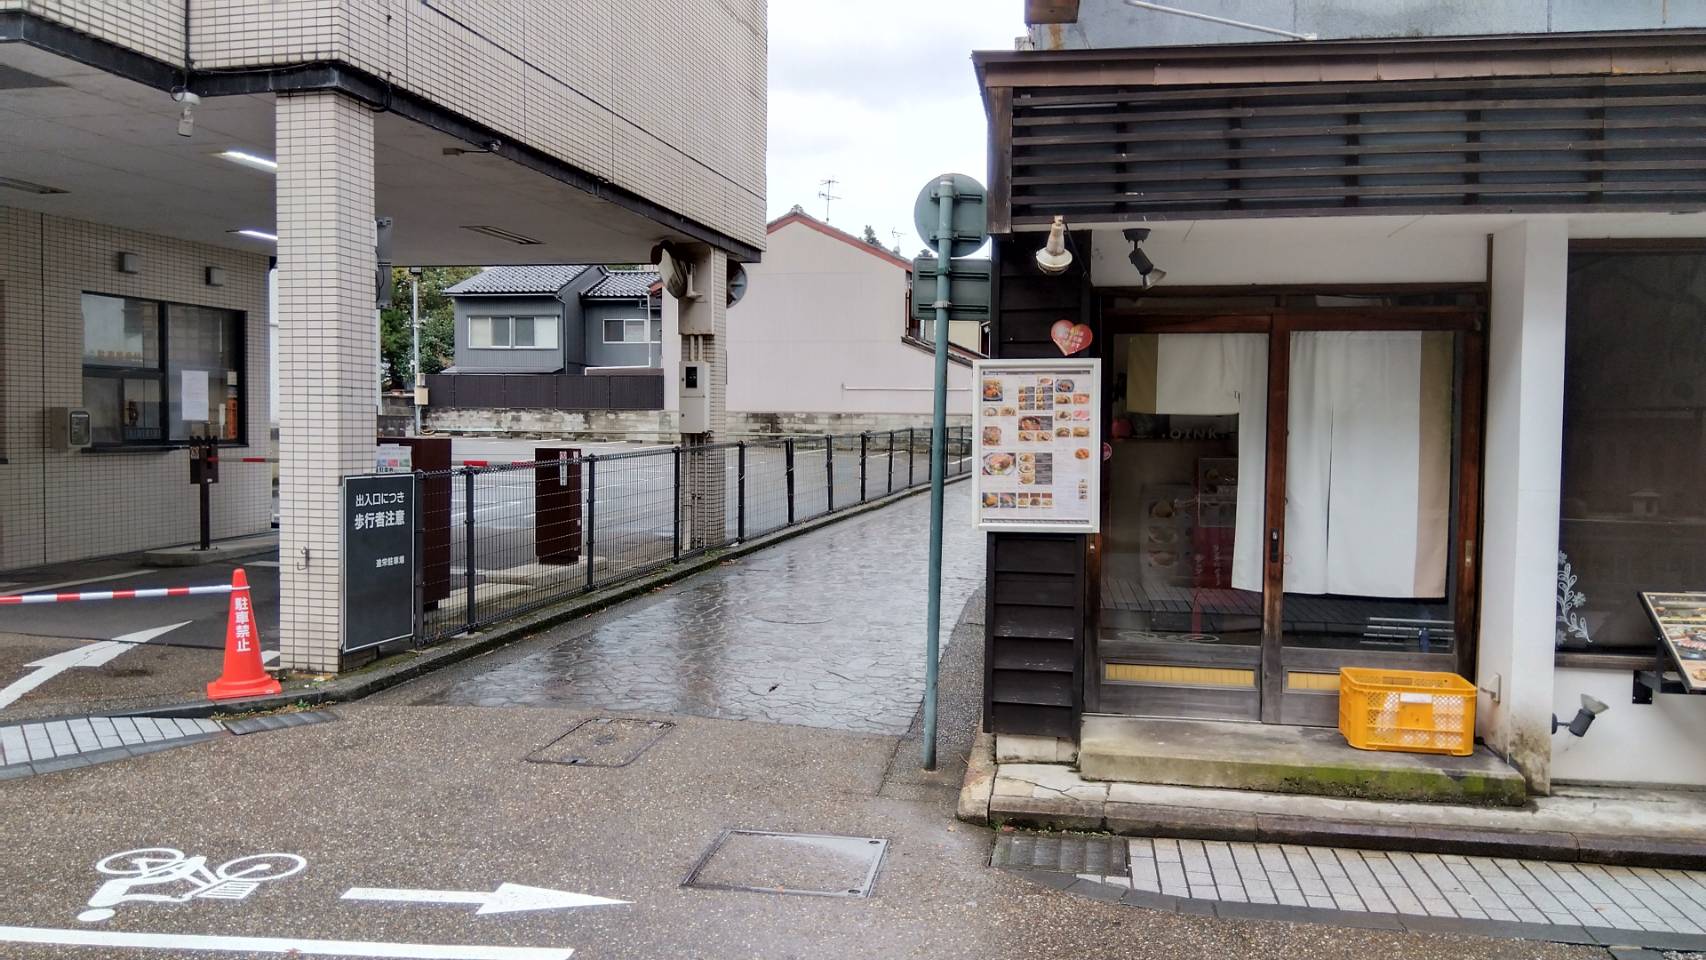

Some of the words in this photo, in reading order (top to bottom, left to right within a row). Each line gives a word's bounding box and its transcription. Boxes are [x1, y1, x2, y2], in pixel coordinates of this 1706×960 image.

[355, 491, 405, 507] 出入口につき
[354, 509, 405, 530] 歩行者注意
[234, 596, 251, 653] 駐車禁止
